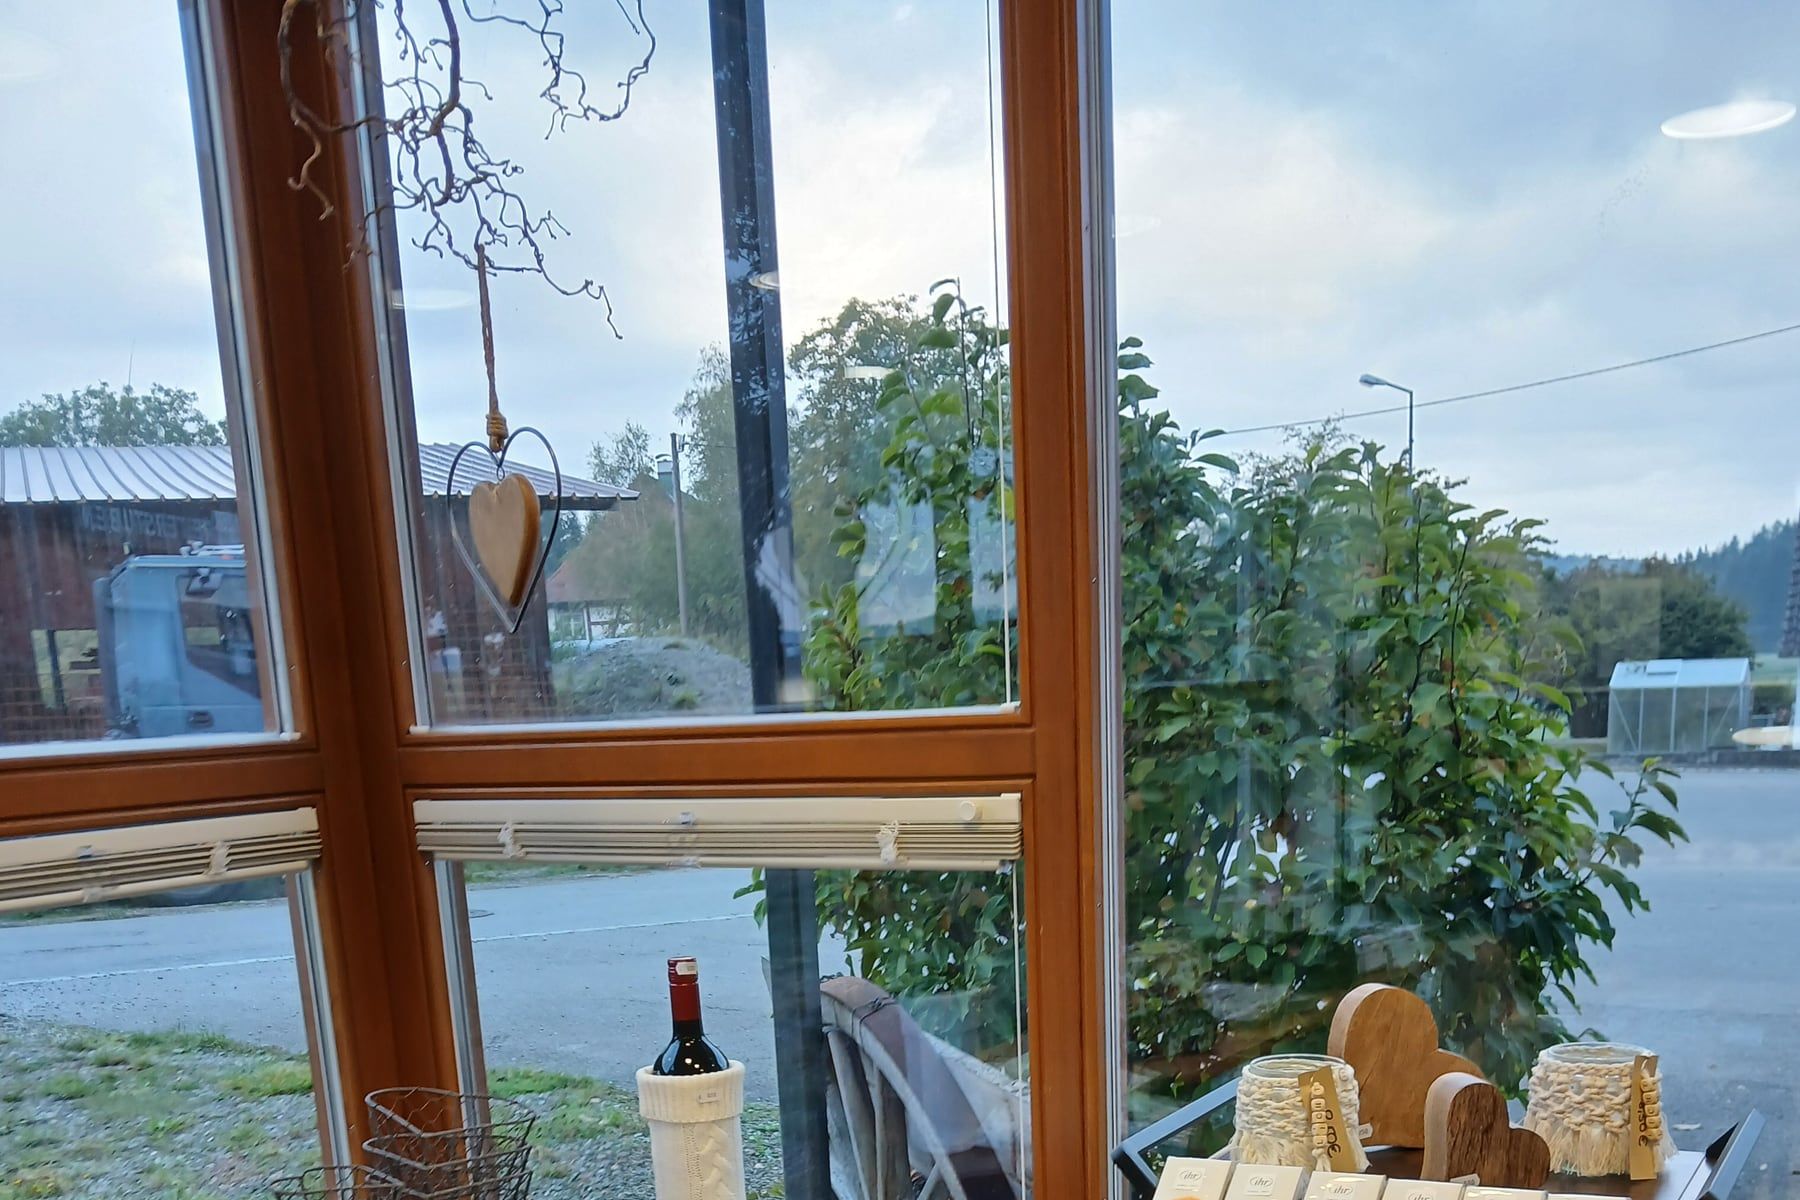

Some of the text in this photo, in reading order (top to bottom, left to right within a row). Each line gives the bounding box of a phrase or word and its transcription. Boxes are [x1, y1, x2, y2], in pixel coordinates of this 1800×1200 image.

[1183, 1169, 1199, 1180] ihr
[1253, 1175, 1270, 1187] ihr
[1333, 1184, 1351, 1196] ihr
